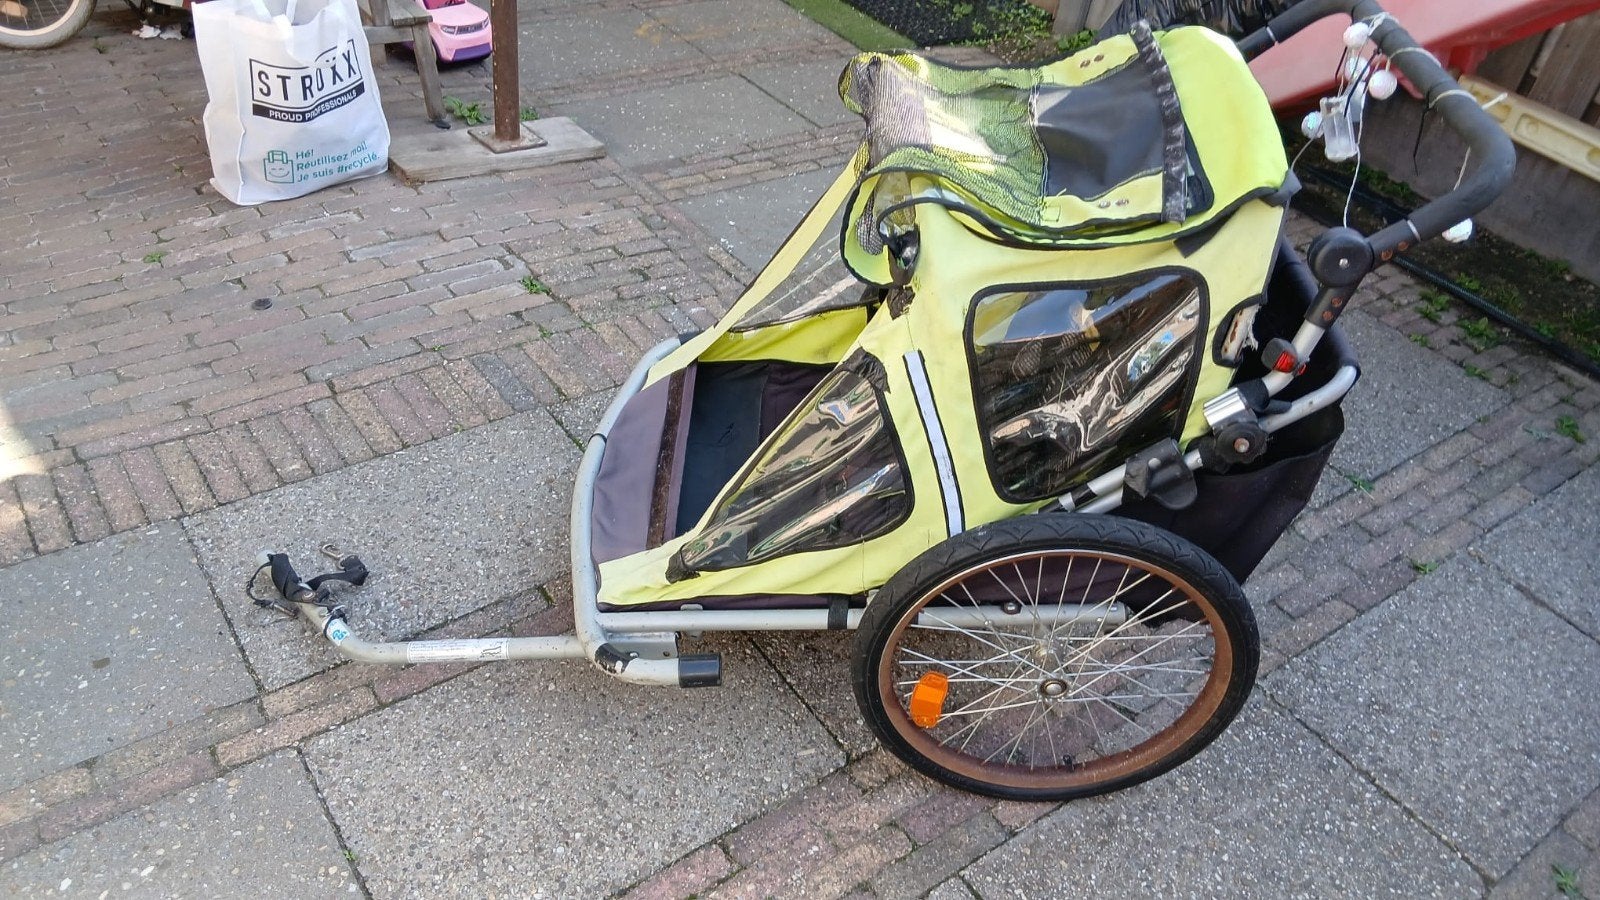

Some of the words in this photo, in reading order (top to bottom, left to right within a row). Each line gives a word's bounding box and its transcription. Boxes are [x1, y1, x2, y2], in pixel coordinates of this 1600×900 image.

[269, 110, 303, 121] PROUD
[305, 90, 357, 121] PROFESSIONALS
[296, 149, 314, 160] Hé!
[297, 153, 348, 171] Réutilisez
[351, 141, 368, 158] moi!
[297, 173, 309, 182] Je
[313, 168, 334, 179] suis
